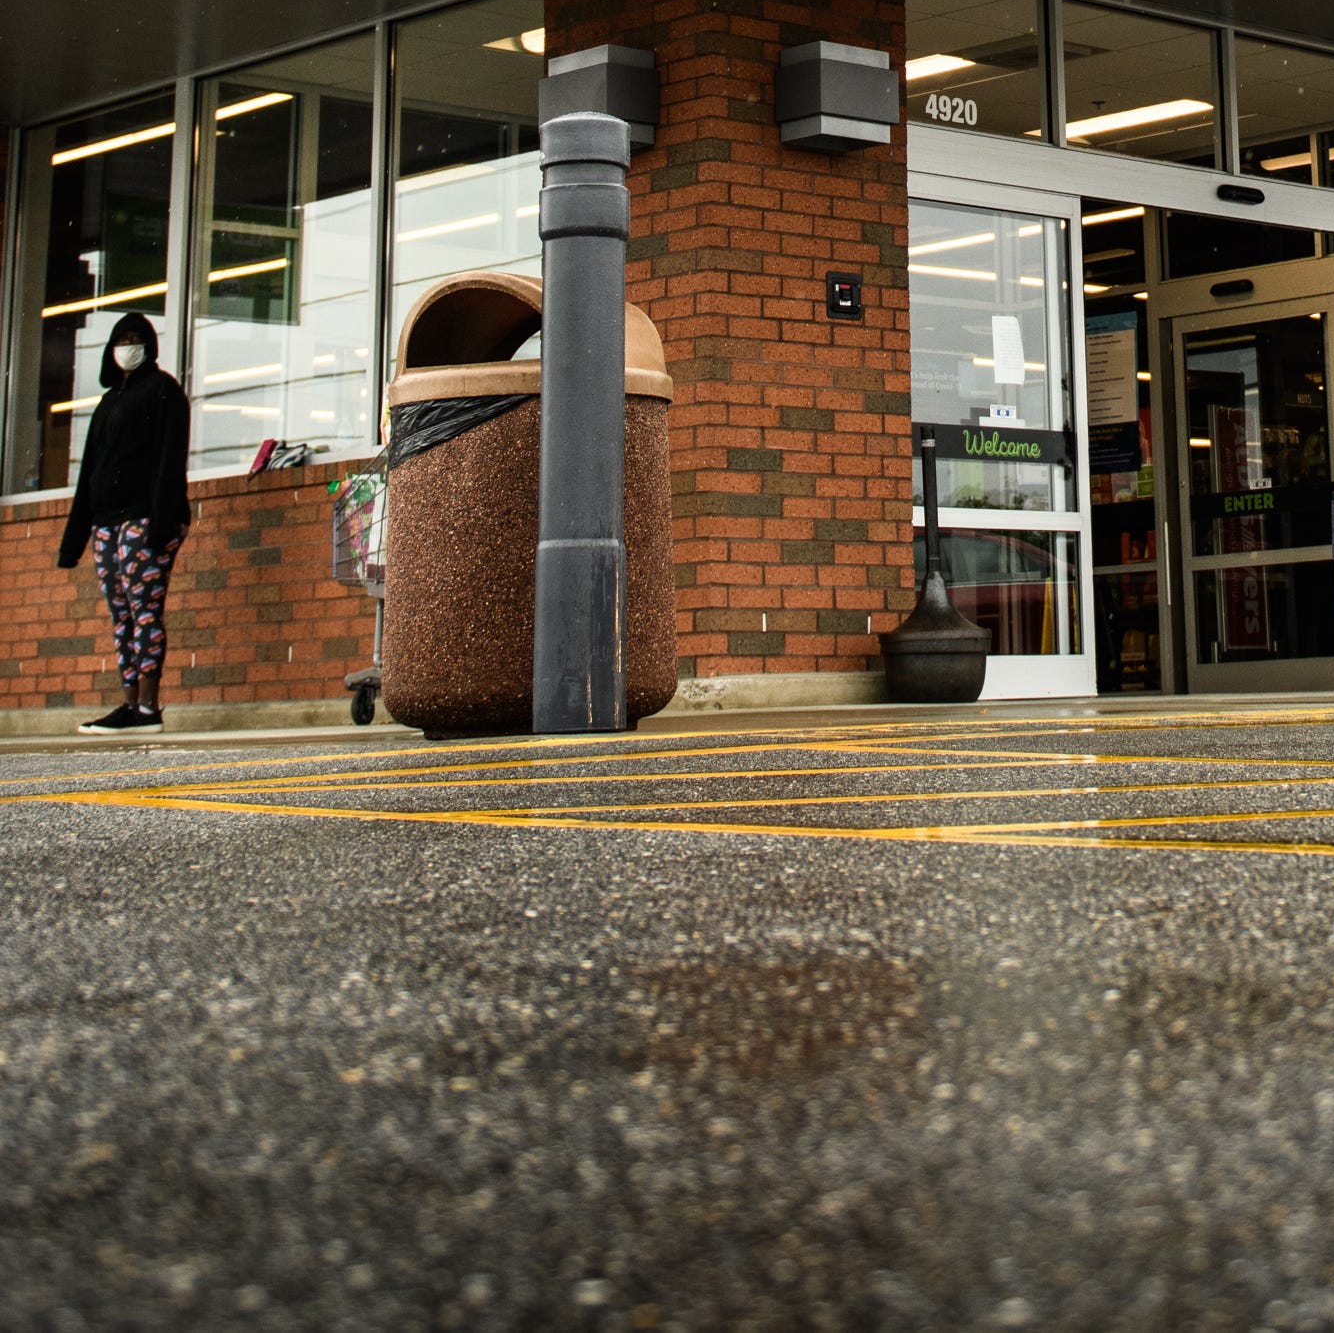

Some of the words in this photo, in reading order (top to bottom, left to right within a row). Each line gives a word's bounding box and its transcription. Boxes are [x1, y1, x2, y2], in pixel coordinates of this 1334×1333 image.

[925, 93, 978, 126] 4920
[962, 429, 1041, 459] Welcome
[1223, 492, 1274, 513] ENTER
